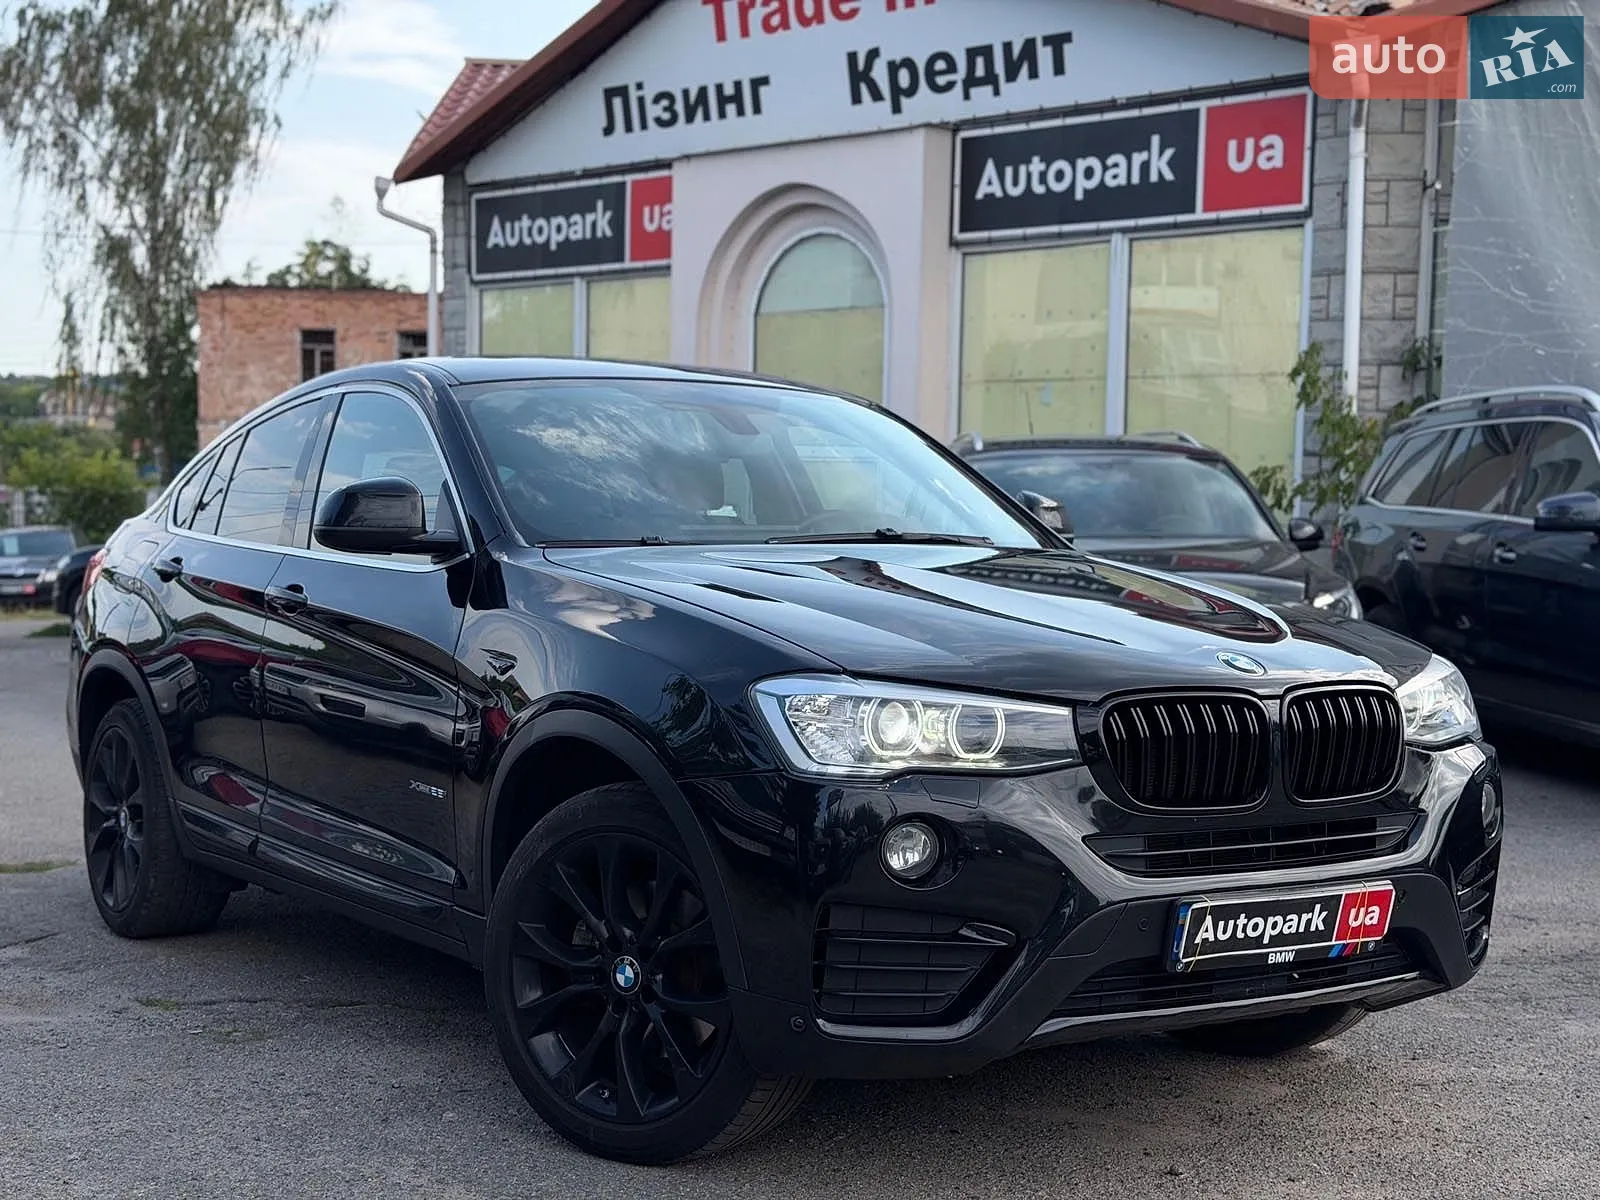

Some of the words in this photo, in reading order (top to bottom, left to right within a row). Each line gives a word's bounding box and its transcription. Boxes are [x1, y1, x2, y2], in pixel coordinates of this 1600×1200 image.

[846, 31, 1073, 115] Кредит
[602, 75, 771, 137] Лізинг
[974, 133, 1176, 201] Autopark
[1226, 134, 1284, 174] ua
[486, 199, 614, 252] Autopark
[1193, 903, 1330, 945] Autopark
[1347, 904, 1381, 928] ua
[1267, 950, 1296, 965] BMW
